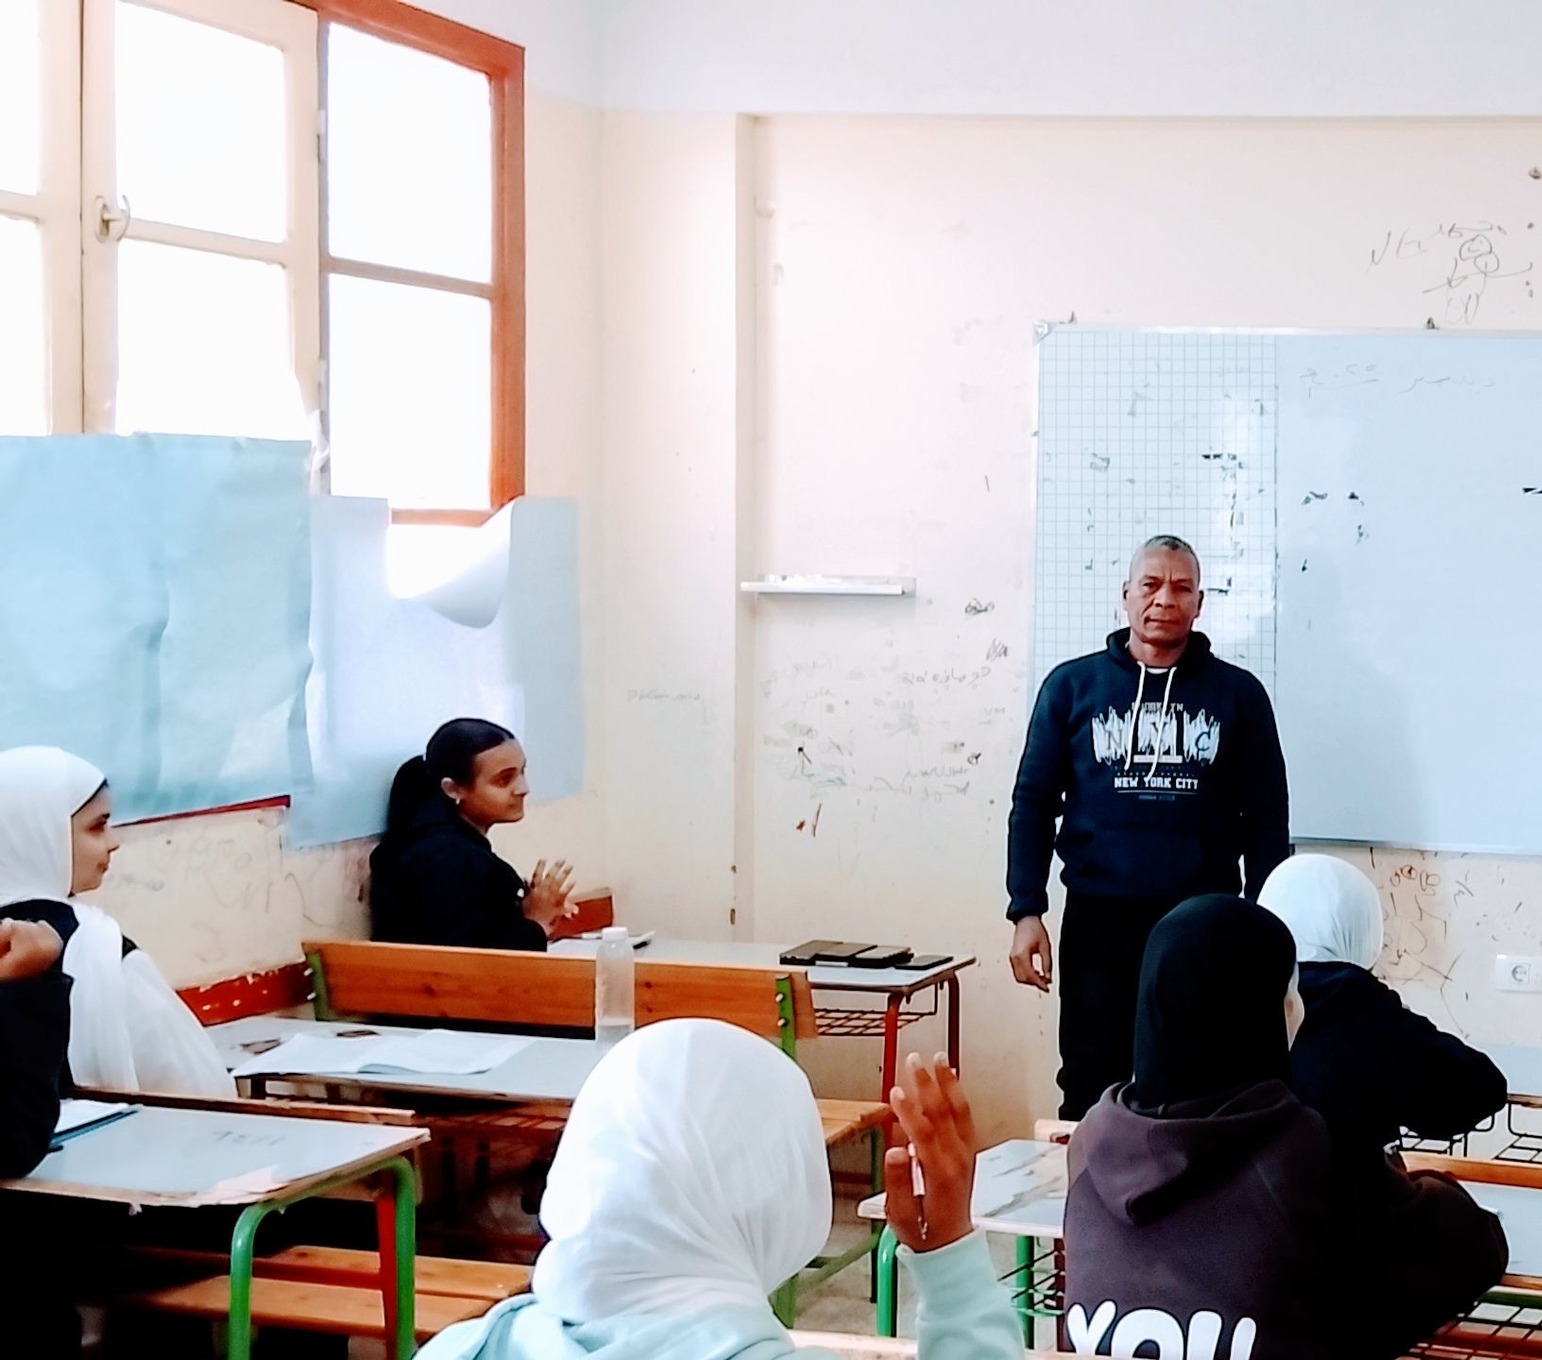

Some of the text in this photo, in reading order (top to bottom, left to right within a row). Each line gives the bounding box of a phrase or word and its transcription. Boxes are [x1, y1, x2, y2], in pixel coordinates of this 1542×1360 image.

[1114, 777, 1199, 790] NEW YORK CITY
